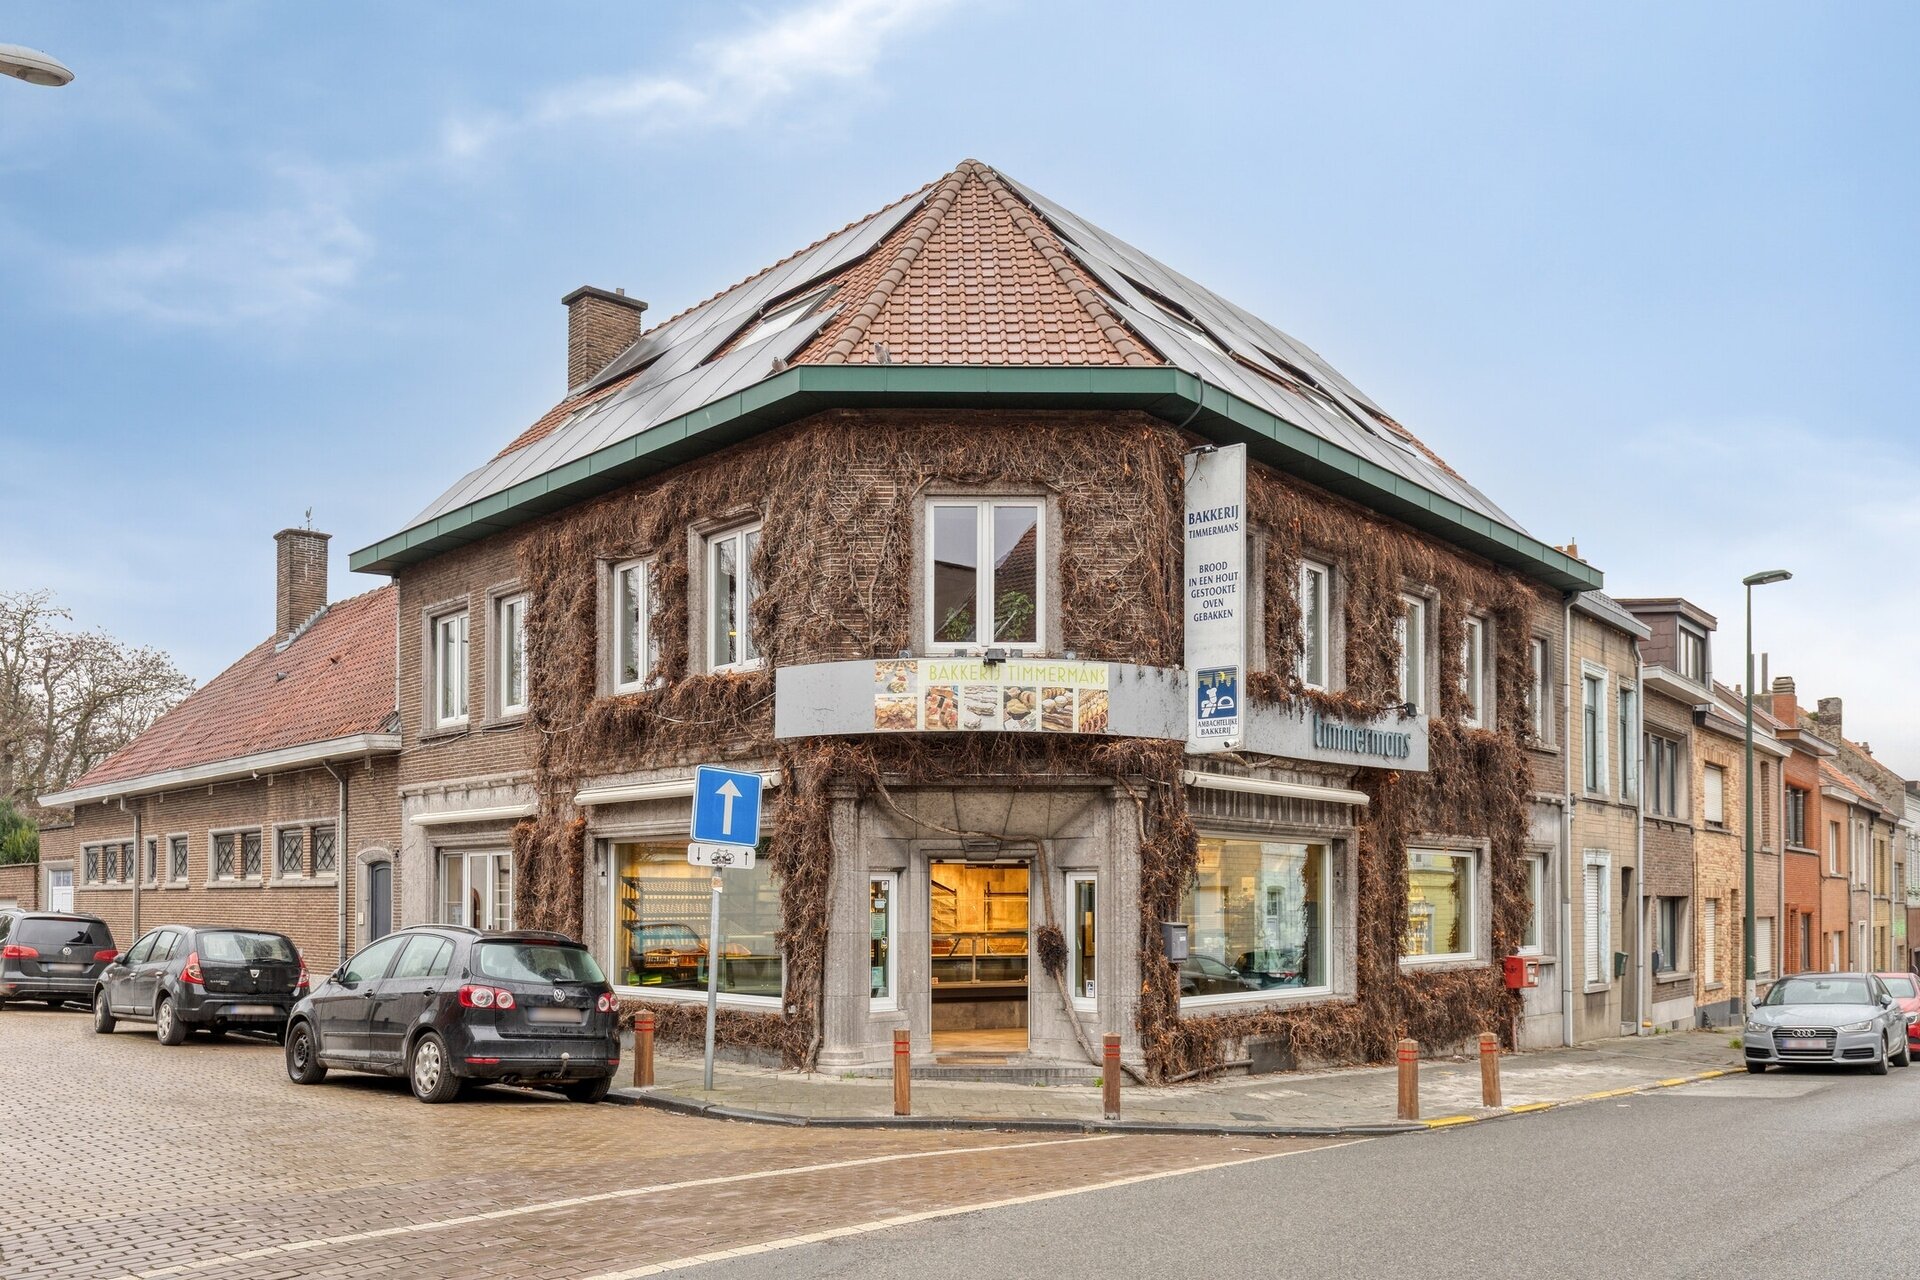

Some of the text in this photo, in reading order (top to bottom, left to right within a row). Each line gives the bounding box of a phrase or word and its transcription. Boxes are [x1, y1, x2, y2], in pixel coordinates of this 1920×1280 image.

[1188, 504, 1238, 525] BAKKERIJ
[1188, 522, 1238, 539] TIMMERMANS
[1199, 561, 1228, 574] BROOD
[1188, 571, 1239, 587] IN EEN HOUT
[1191, 584, 1236, 598] GESTOOKTE
[1202, 598, 1224, 609] OVEN
[1193, 609, 1234, 622] GEBAKKEN
[929, 664, 1106, 685] BAKKERIJ TIMMERMANS
[1198, 718, 1238, 727] AMBACHTELIJKE
[1201, 727, 1230, 736] BAKKERIJ
